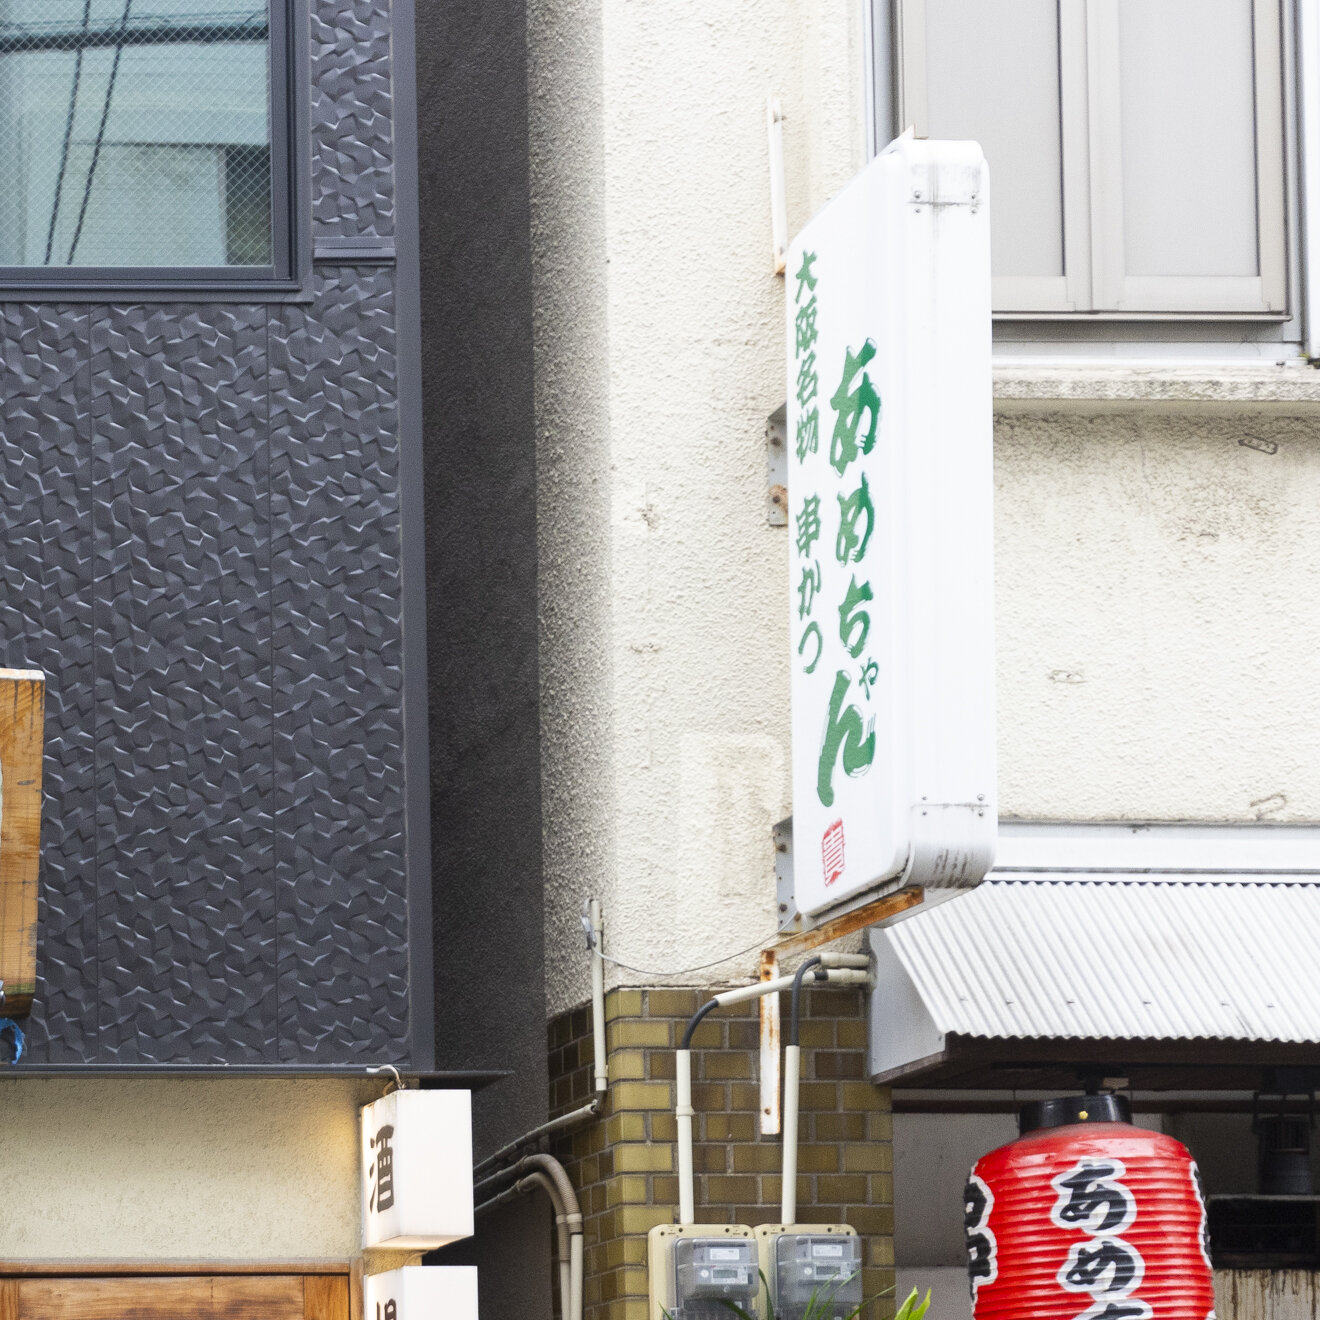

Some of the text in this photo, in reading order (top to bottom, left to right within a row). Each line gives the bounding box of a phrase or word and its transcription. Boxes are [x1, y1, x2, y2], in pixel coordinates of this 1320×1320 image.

[795, 248, 822, 675] 大阪名物 串かつ
[816, 336, 882, 808] あめちゃん
[370, 1124, 394, 1213] 酒
